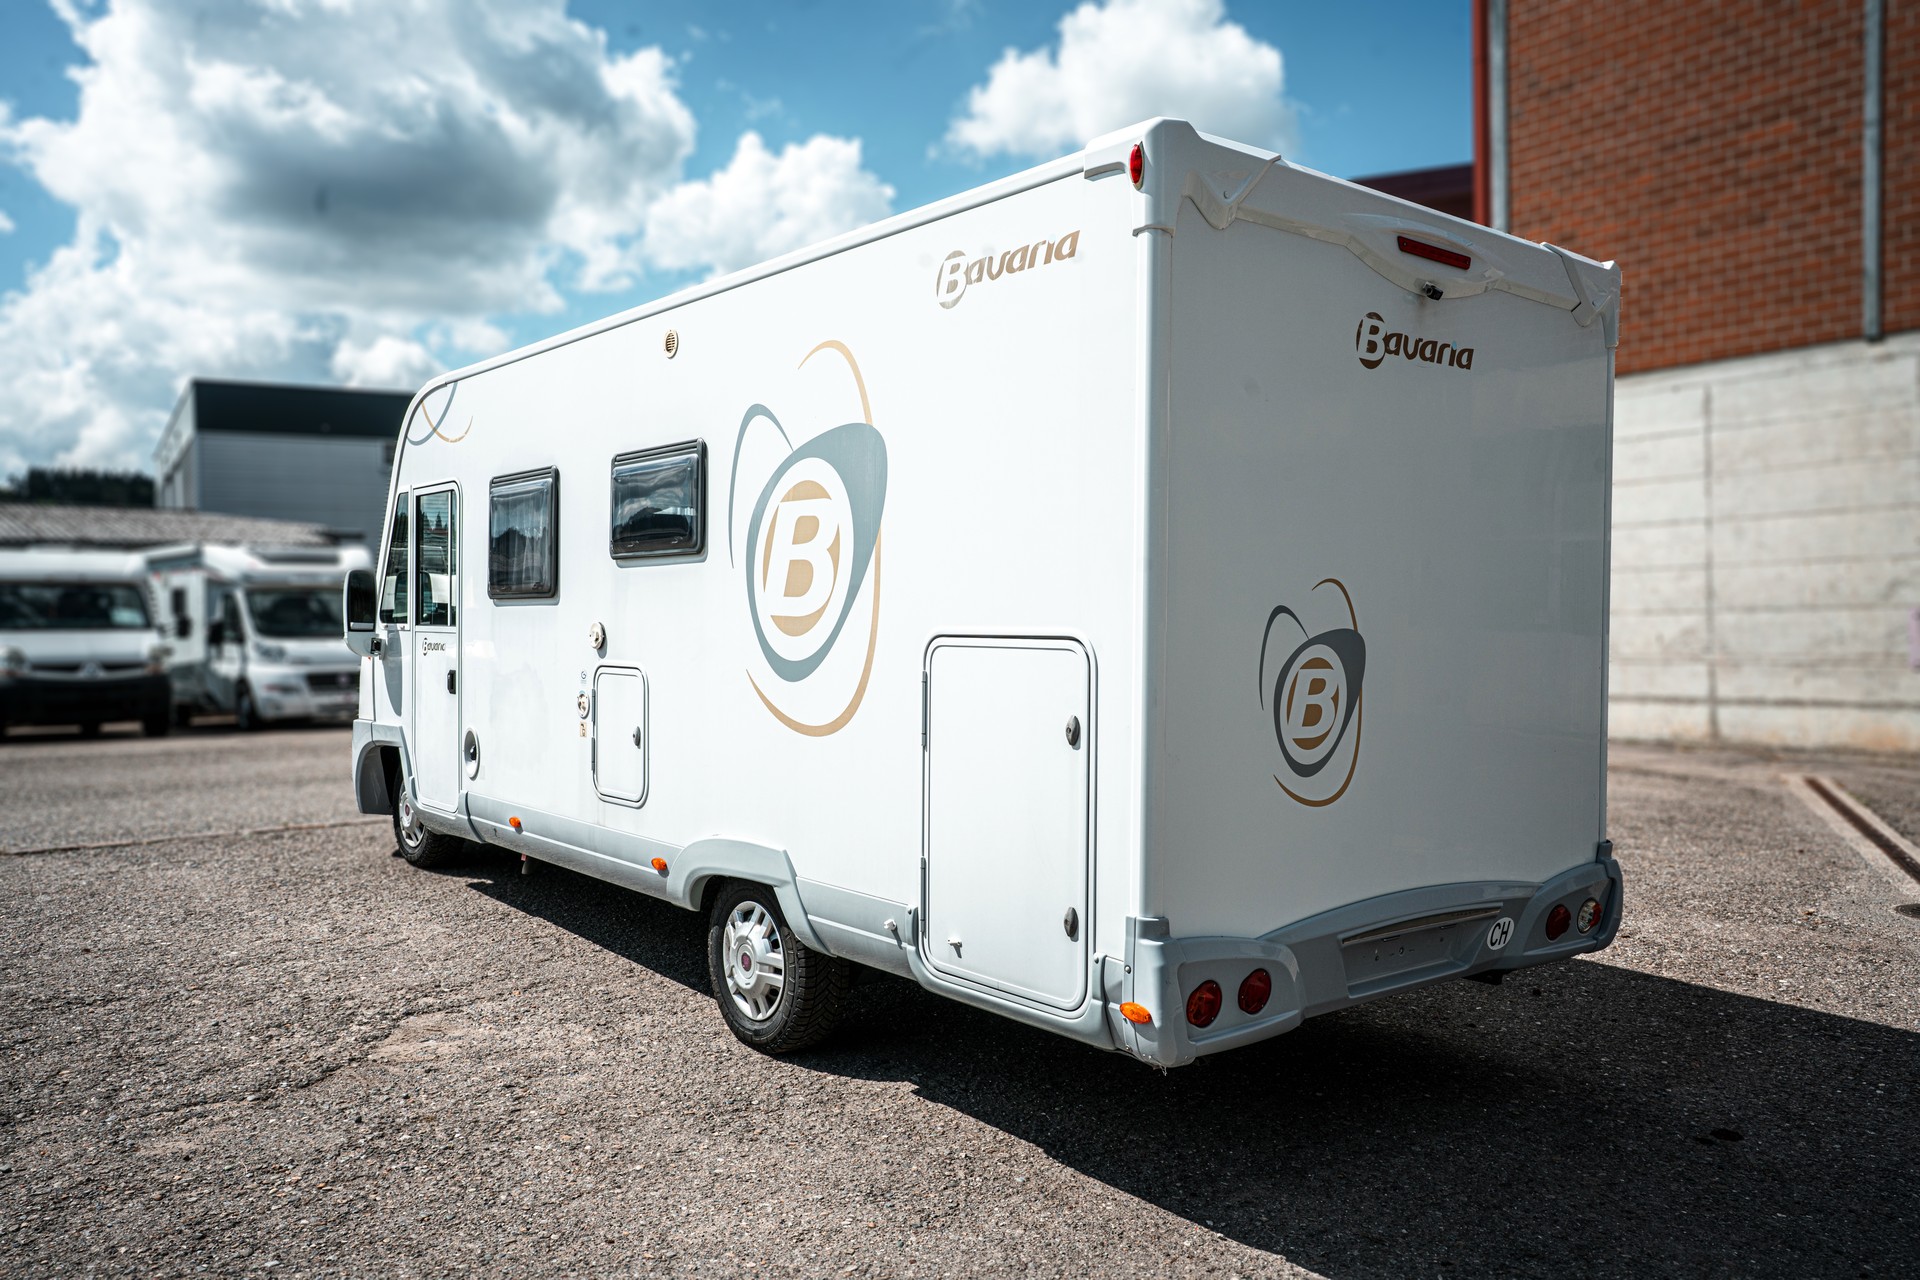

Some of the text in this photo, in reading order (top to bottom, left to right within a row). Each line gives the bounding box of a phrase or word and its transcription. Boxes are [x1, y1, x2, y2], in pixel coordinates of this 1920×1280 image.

[936, 230, 1080, 309] Bavaria
[1356, 311, 1475, 370] Bavaria
[764, 498, 841, 616] B
[1288, 668, 1340, 740] B
[1490, 920, 1511, 946] CH
